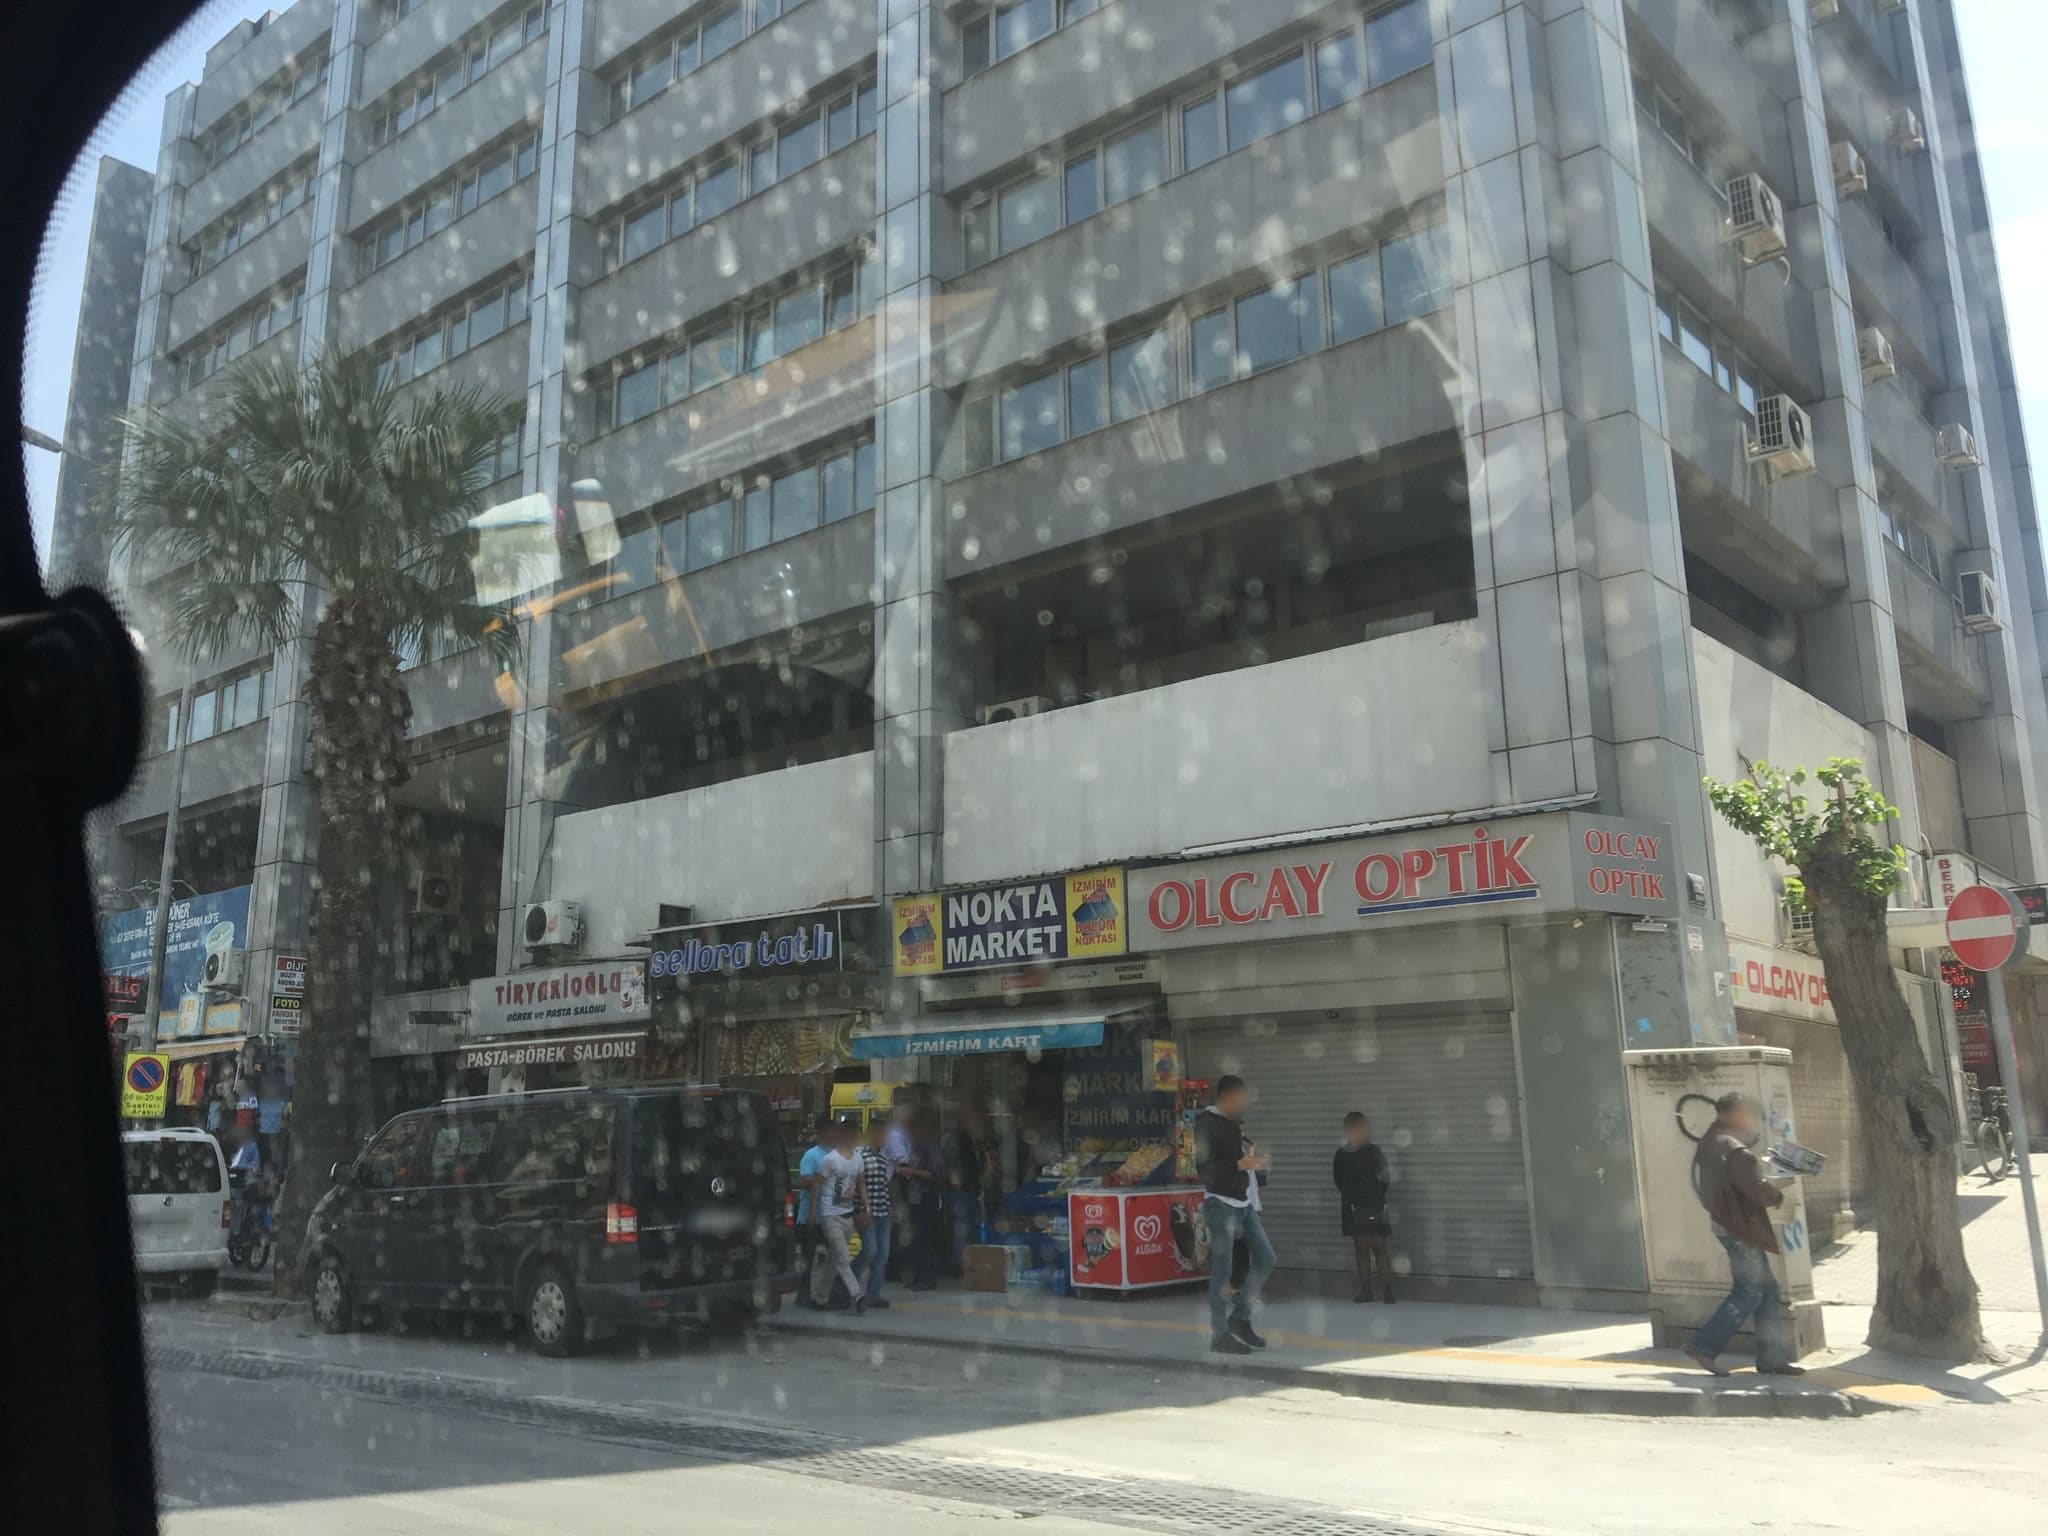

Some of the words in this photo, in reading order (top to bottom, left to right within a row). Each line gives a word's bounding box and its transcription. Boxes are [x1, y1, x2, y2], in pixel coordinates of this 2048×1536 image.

[1584, 827, 1661, 861] OLCAY
[1146, 860, 1335, 932] OLCAY
[1353, 828, 1538, 902] OPTİK
[1588, 864, 1666, 901] OPTİK
[948, 884, 1058, 929] NOKTA
[757, 923, 833, 967] tatlı
[947, 924, 1062, 965] MARKET
[1745, 959, 1805, 1002] OLCAY
[275, 998, 300, 1009] FOTO
[506, 1009, 533, 1023] BÖREK
[545, 1008, 572, 1018] PASTA
[573, 1004, 607, 1016] SALONU
[466, 1046, 567, 1068] PASTA-BÖREK
[573, 1040, 637, 1061] SALONU
[905, 1036, 981, 1053] İZMİRİM
[988, 1034, 1041, 1049] KART
